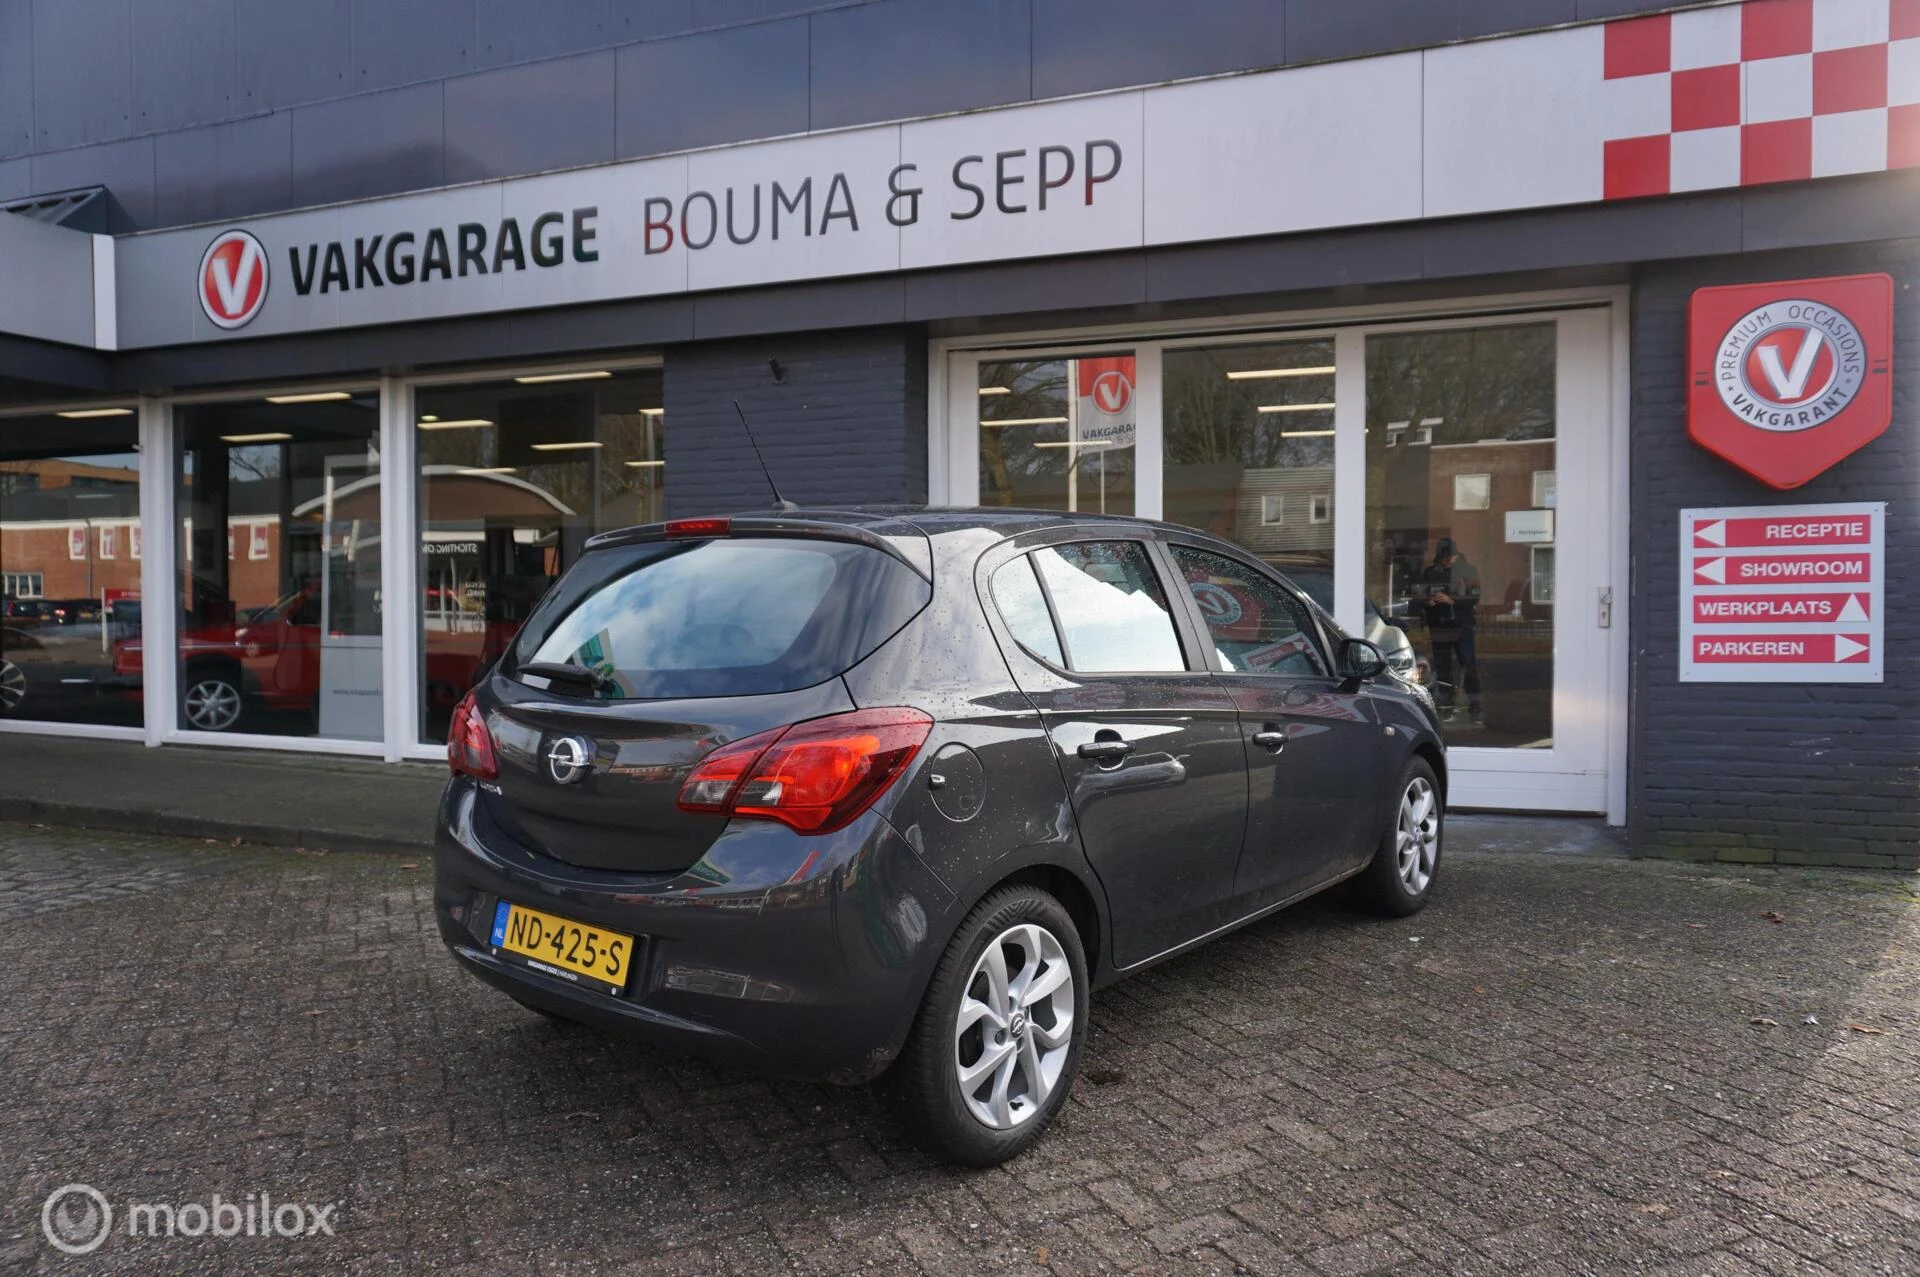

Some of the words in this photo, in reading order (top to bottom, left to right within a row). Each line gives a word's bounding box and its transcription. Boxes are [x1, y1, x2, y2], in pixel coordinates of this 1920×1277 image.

[289, 206, 599, 295] VAKGARAGE
[643, 172, 859, 255] BOUMA
[885, 163, 923, 227] &
[950, 138, 1122, 220] SEPP
[1722, 310, 1773, 381] PREMIUM
[1788, 304, 1860, 374] OCCASIONS
[1732, 387, 1848, 427] VAKGARANT
[1082, 423, 1136, 440] VAKGARA
[1765, 522, 1863, 539] RECEPTIE
[1740, 560, 1863, 577] SHOWROOM
[1699, 600, 1832, 616] WERKPLAATS
[1699, 641, 1805, 656] PARKEREN
[494, 927, 504, 940] NL
[510, 911, 624, 976] ND-425-S
